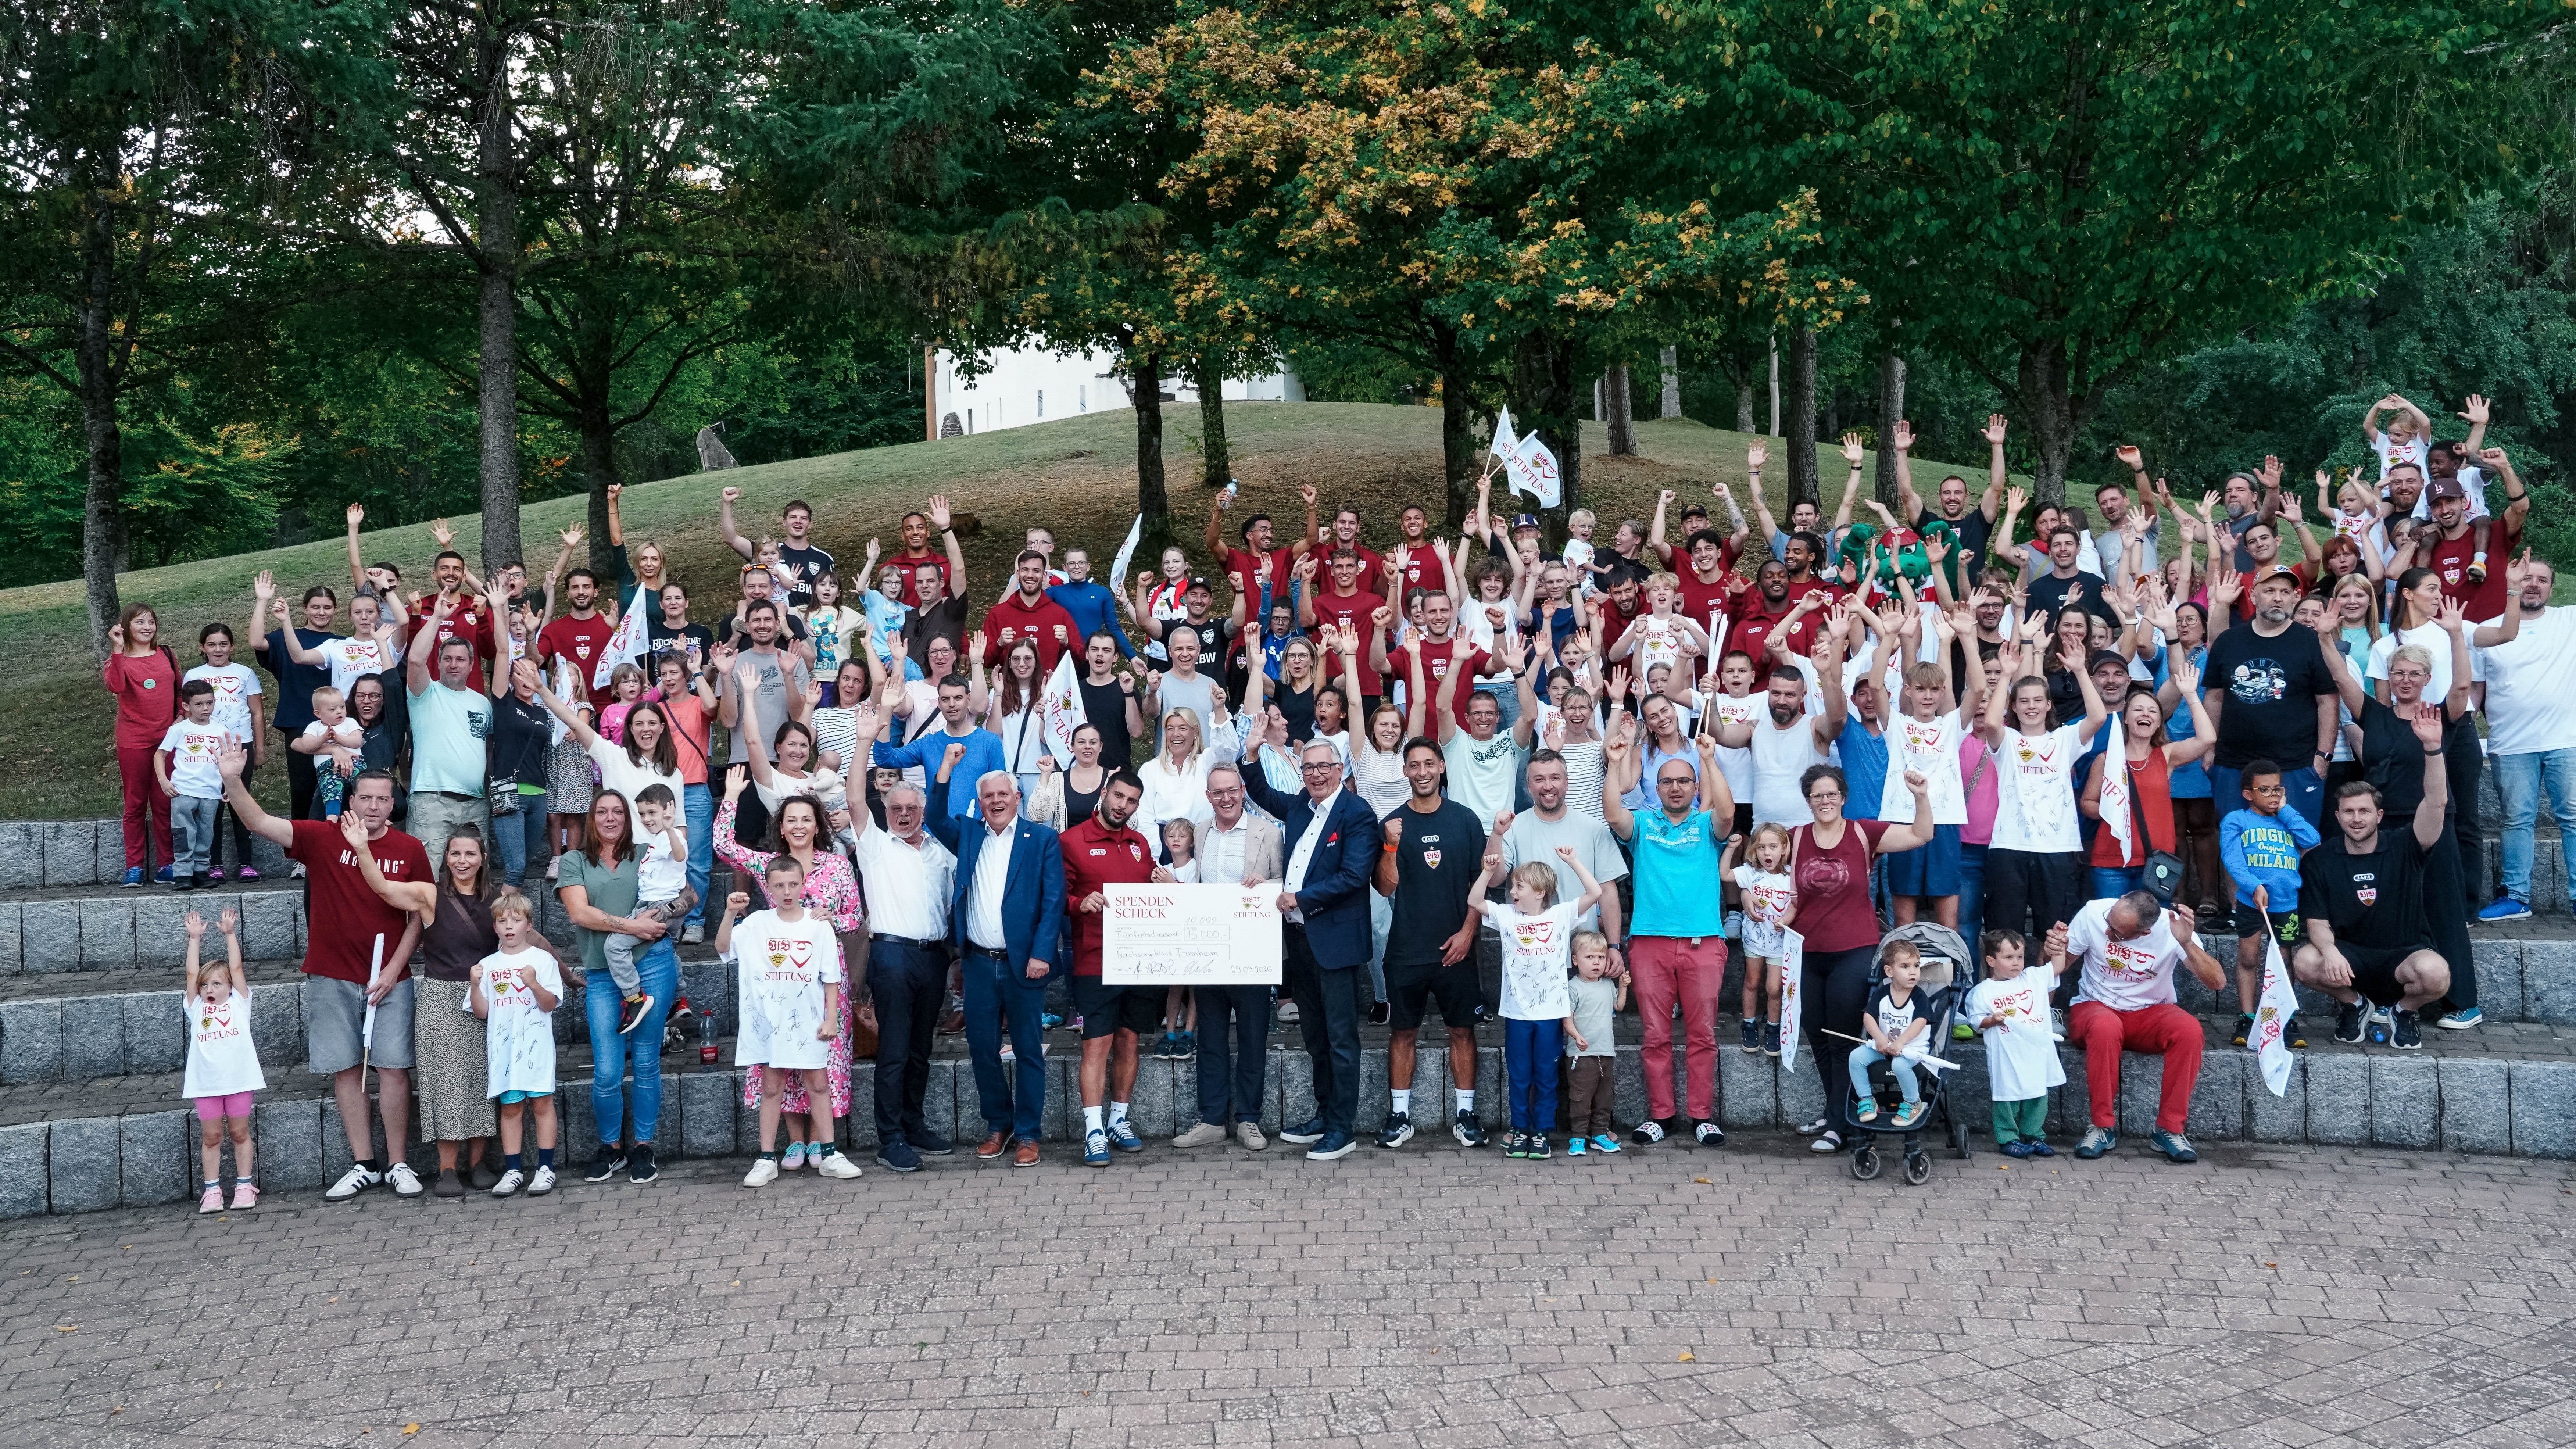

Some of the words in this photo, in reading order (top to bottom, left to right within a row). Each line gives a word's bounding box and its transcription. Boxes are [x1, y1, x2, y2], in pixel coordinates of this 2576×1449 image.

[1511, 455, 1552, 497] STIFTUNG
[791, 583, 812, 595] BW
[1647, 631, 1664, 639] VfB
[345, 647, 366, 656] VfB
[1645, 652, 1678, 661] STIFTUN
[1720, 706, 1736, 715] VfB
[186, 736, 205, 745] VfB
[1904, 743, 1944, 754] STIFTUNG
[2258, 842, 2286, 853] Original
[1754, 884, 1773, 898] VfB
[1115, 896, 1179, 906] SPENDEN-
[1115, 908, 1166, 918] SCHECK
[1516, 924, 1535, 935] VfB
[768, 940, 791, 953] VfB
[1516, 947, 1556, 956] STIFTUNG
[2106, 942, 2132, 960] VfB
[1175, 948, 1219, 958] Tannheim
[490, 969, 512, 981] VfB
[765, 971, 811, 983] STIFTUNG
[1993, 995, 2017, 1009] VfB
[197, 1028, 239, 1042] STIFTUNG
